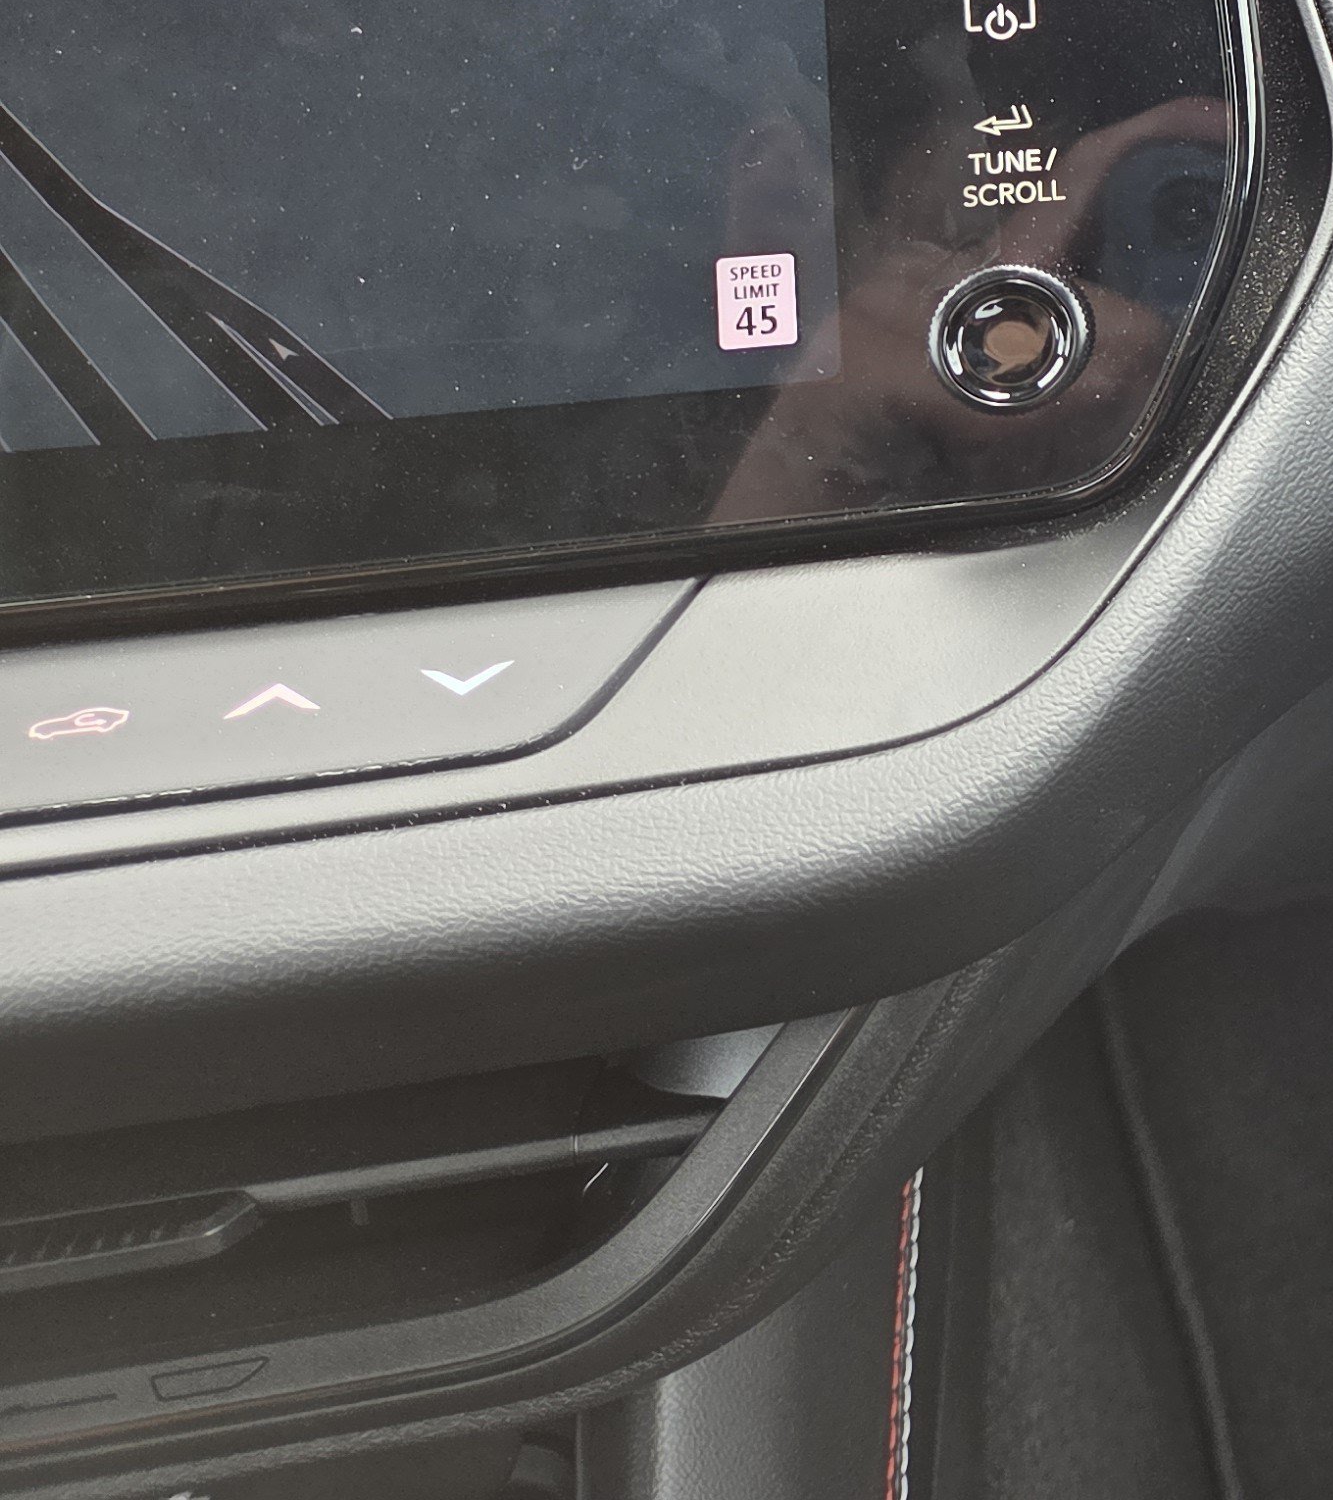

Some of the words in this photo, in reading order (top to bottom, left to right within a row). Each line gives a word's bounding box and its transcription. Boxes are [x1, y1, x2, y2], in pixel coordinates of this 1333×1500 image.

[967, 147, 1058, 176] TUNE/
[962, 179, 1067, 208] SCROLL
[729, 262, 782, 282] SPEED
[733, 283, 780, 301] LIMIT
[735, 304, 779, 337] 45
